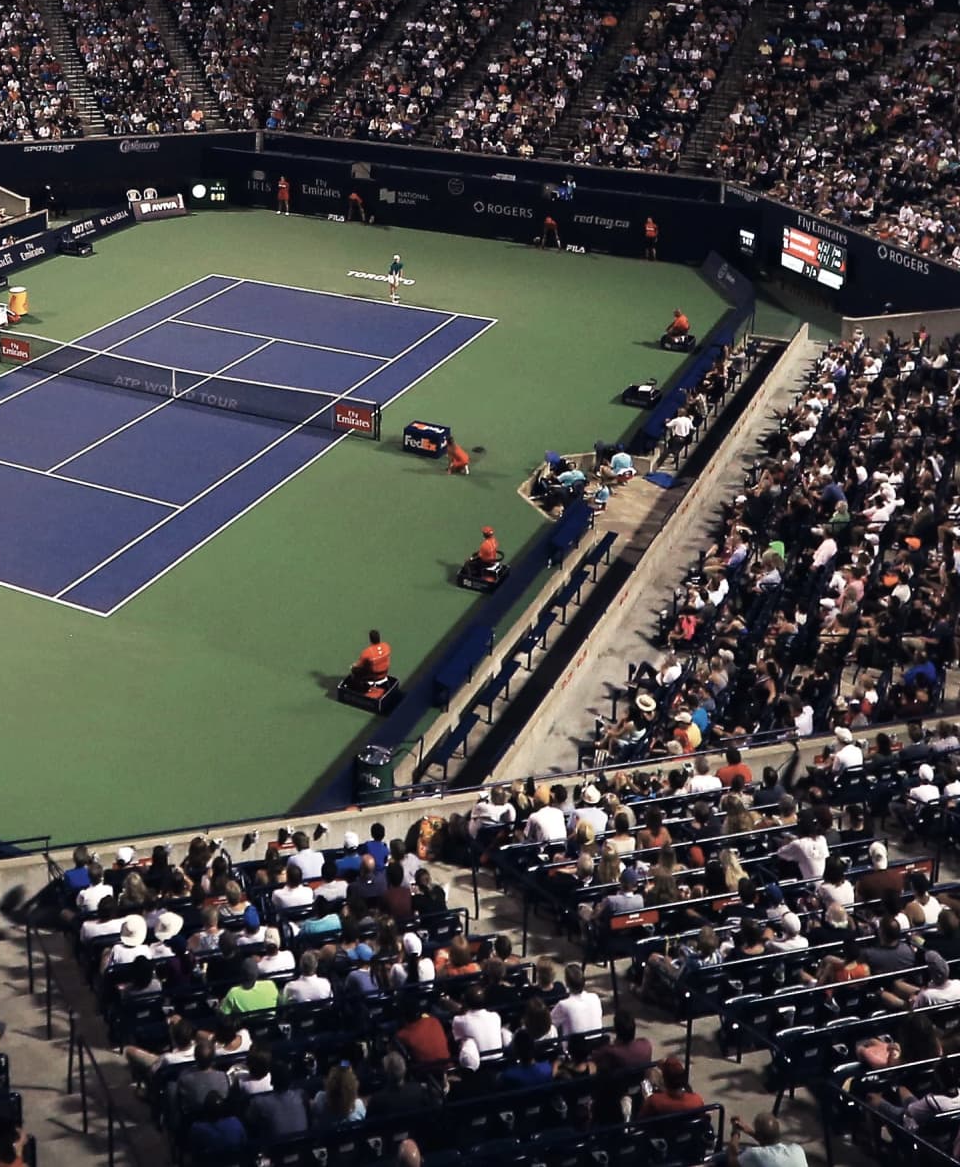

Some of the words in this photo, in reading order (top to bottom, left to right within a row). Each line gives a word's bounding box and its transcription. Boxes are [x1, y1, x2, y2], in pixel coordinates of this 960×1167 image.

[302, 184, 341, 198] Emirates
[152, 201, 178, 212] AVIVA
[487, 203, 533, 219] ROGERS
[327, 213, 345, 222] FILA
[798, 214, 812, 232] Fly
[812, 220, 848, 245] Emirates
[566, 244, 586, 254] FILA
[889, 249, 930, 275] ROGERS
[113, 375, 141, 387] ATP
[200, 392, 239, 409] TOUR
[336, 414, 370, 428] Emirates
[404, 434, 438, 452] FedEx
